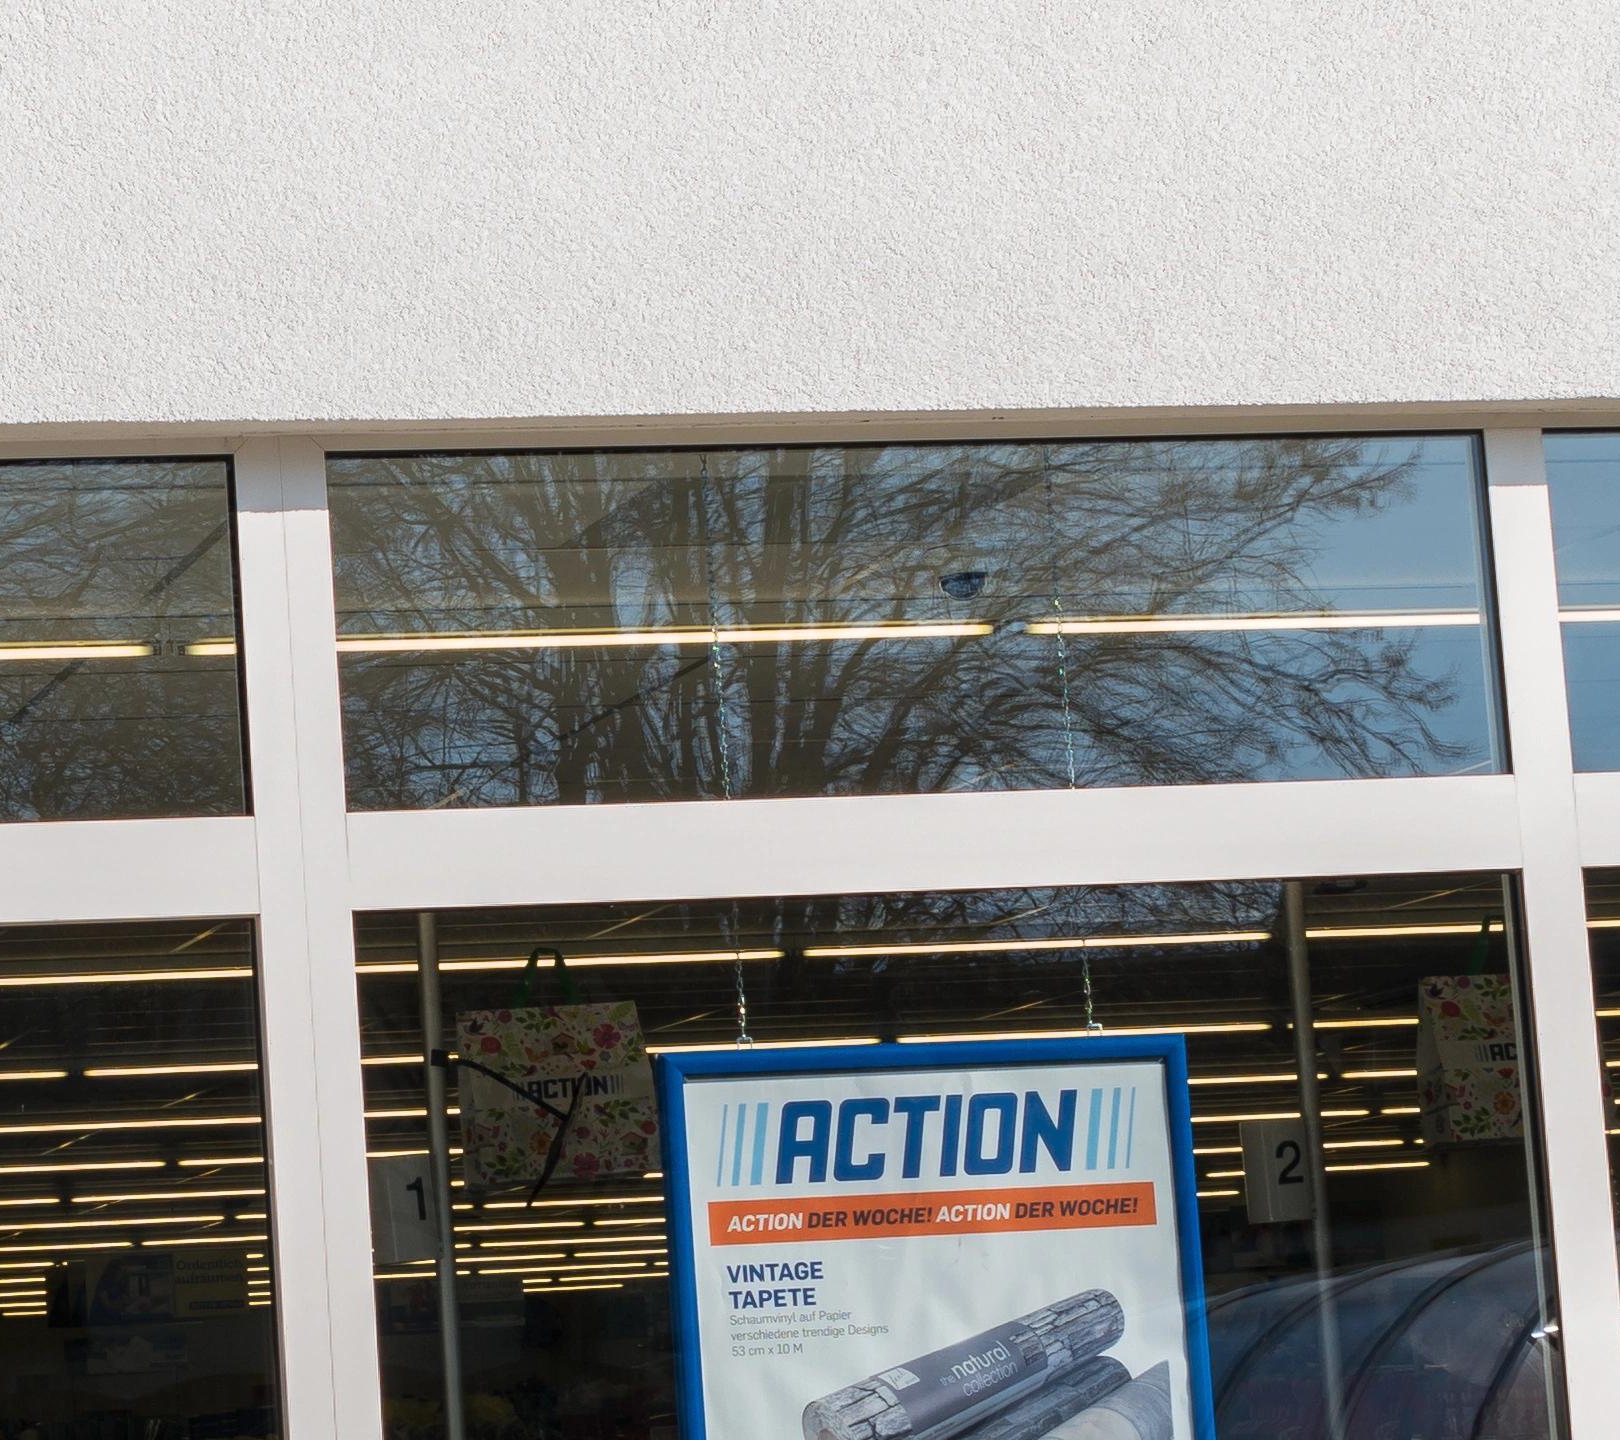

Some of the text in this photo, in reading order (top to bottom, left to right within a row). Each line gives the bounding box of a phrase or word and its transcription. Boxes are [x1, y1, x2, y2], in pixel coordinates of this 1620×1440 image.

[774, 1089, 1078, 1185] ACTION
[1274, 1139, 1304, 1185] 2
[727, 1197, 1139, 1233] ACTION DER WOCHE! ACTION DER WOCHE!
[726, 1261, 824, 1283] VINTAGE
[728, 1287, 817, 1309] TAPETE
[729, 1309, 852, 1326] Schaumvinyl auf Papier
[730, 1323, 889, 1342] verschiedene trendige Designs
[731, 1345, 746, 1357] 53
[748, 1346, 765, 1356] cm
[777, 1344, 791, 1355] 10
[792, 1343, 804, 1354] M
[939, 1373, 955, 1387] the
[950, 1340, 1012, 1380] natural
[962, 1361, 1019, 1397] collection
